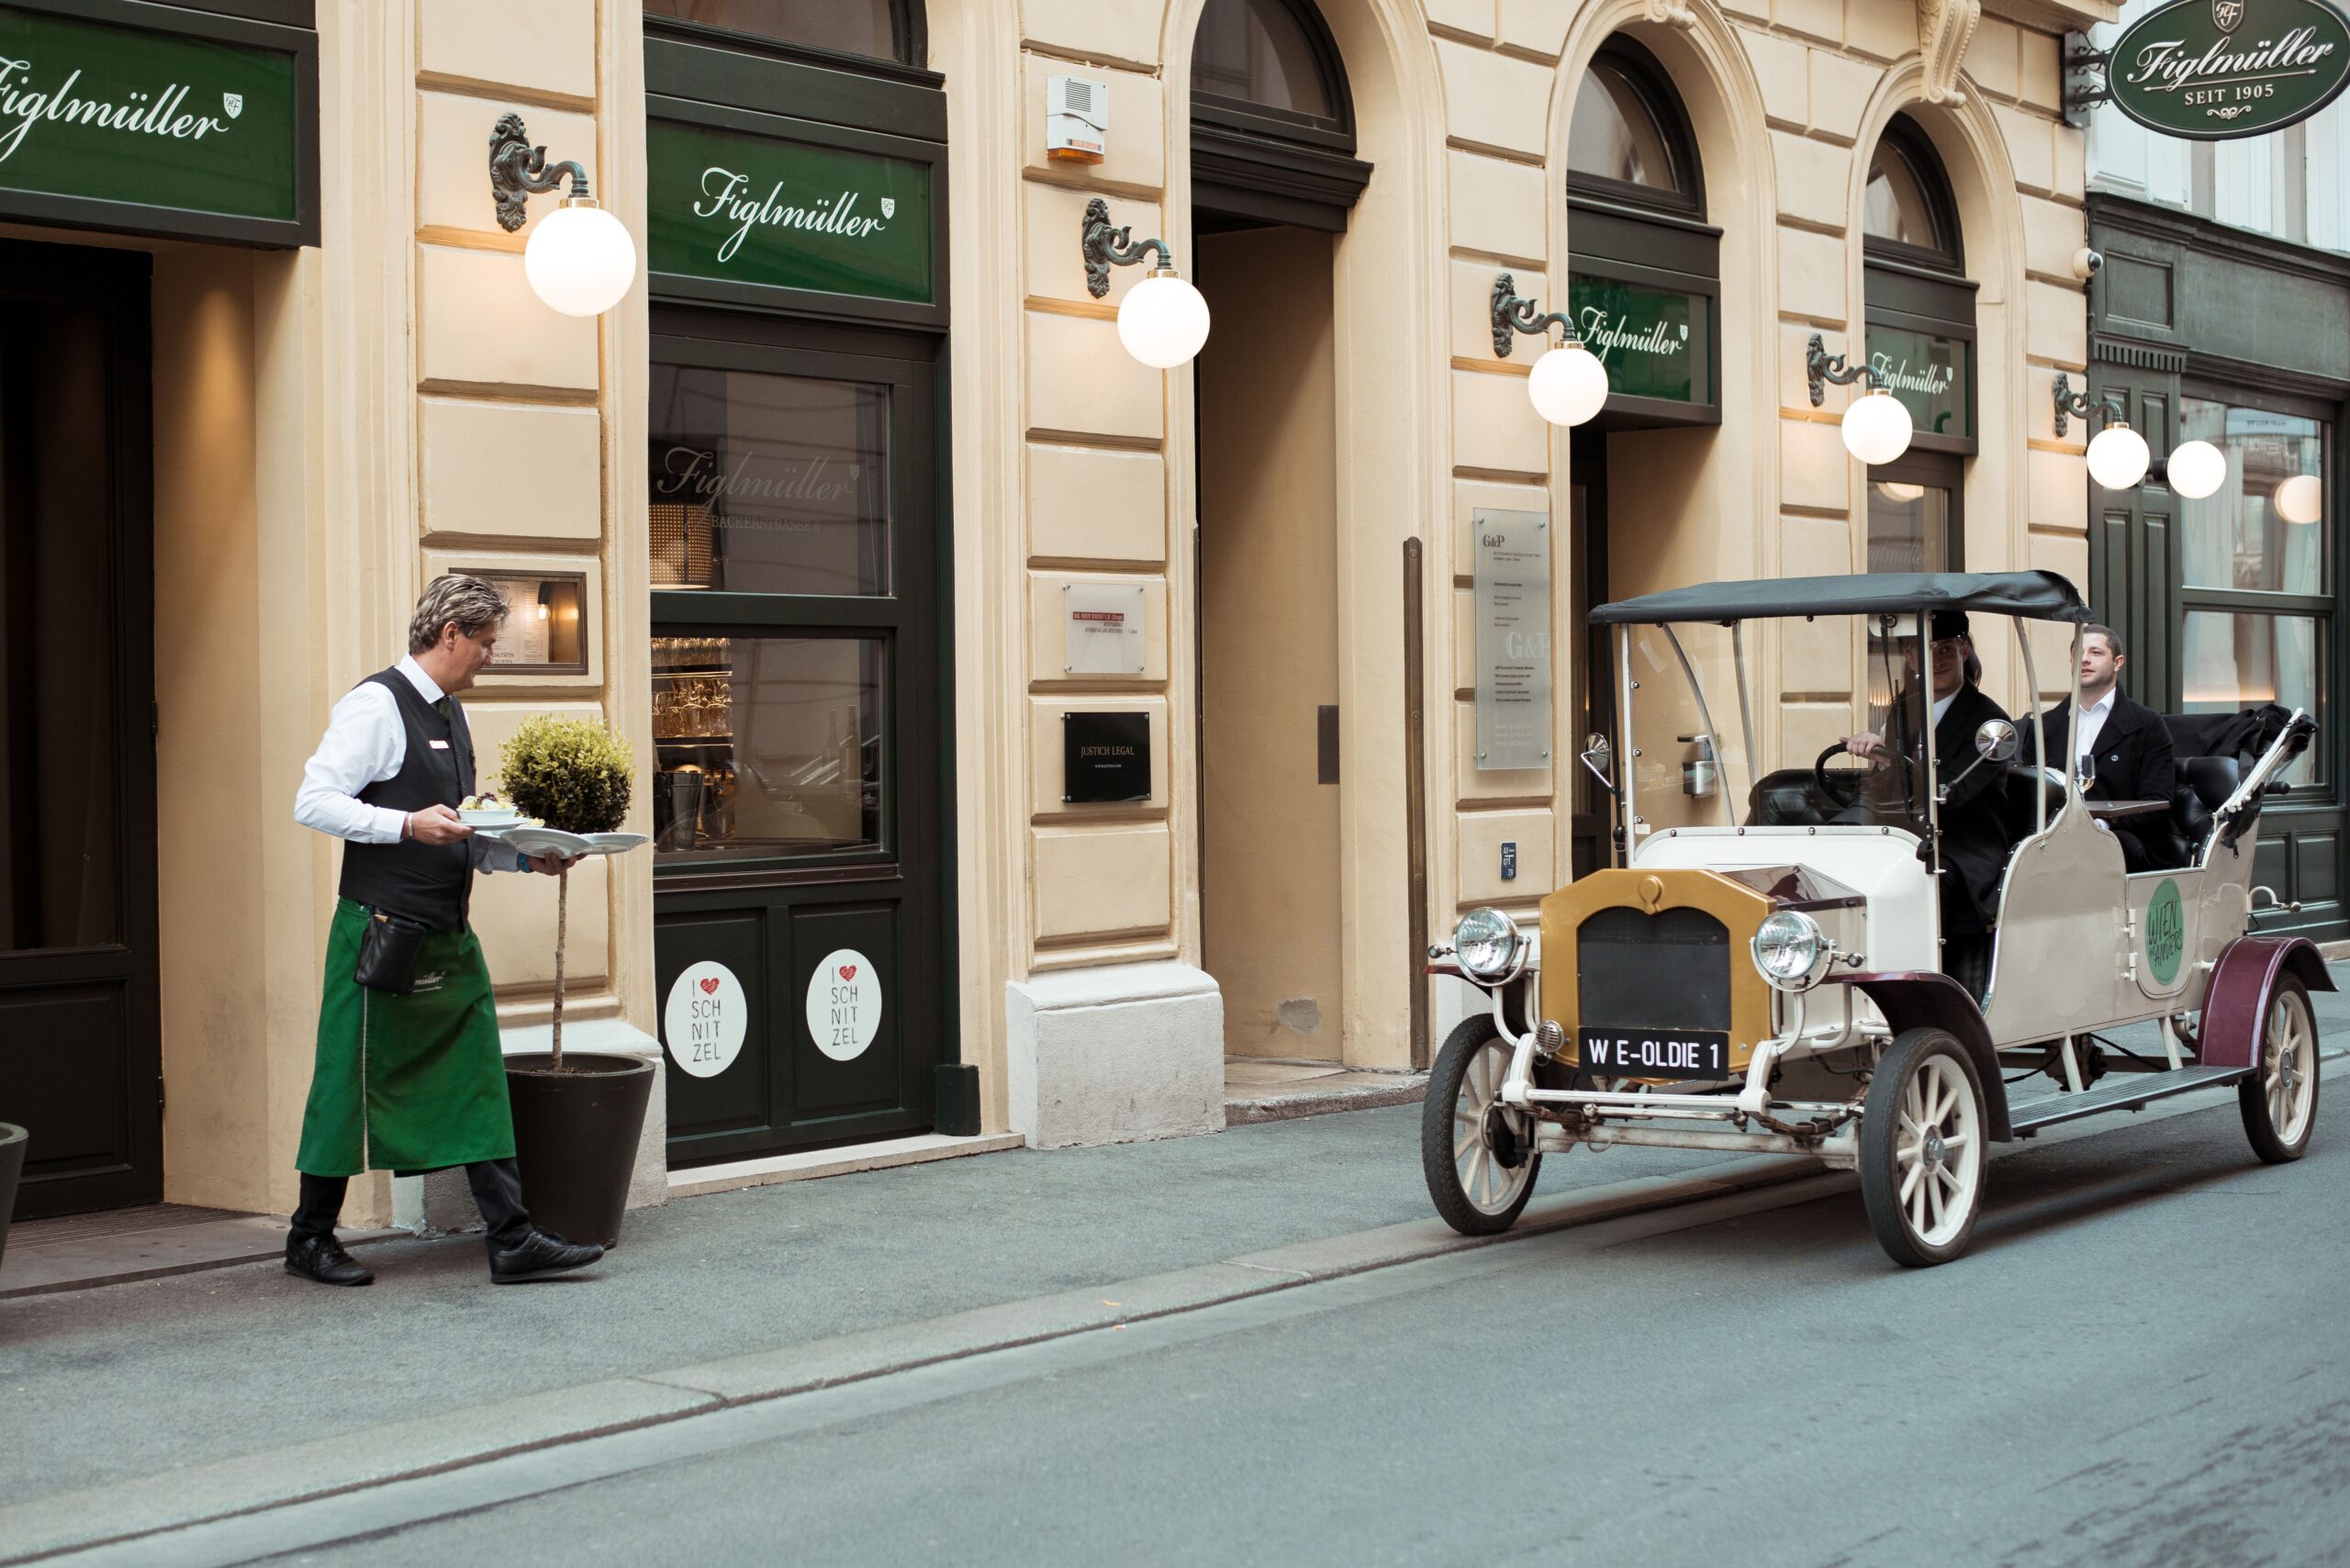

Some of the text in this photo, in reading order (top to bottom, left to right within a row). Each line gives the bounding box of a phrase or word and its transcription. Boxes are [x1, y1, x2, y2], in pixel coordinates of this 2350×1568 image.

[2126, 26, 2335, 92] Figlmüller
[2184, 84, 2275, 106] SEIT 1905
[693, 166, 886, 263] Figlmüller
[1576, 306, 1683, 364] Figlmüller
[1869, 351, 1949, 395] Figlmüller
[656, 446, 854, 532] Figlmüller
[1482, 534, 1505, 547] G&P
[1080, 745, 1136, 758] JUSTICH LEGAL
[2148, 899, 2179, 946] WIEN
[2154, 927, 2183, 967] ANDERS
[831, 966, 834, 983] I
[691, 979, 696, 997] I
[831, 985, 858, 1004] SCH
[691, 999, 722, 1019] SCH
[831, 1005, 858, 1025] NIT
[691, 1020, 722, 1040] NIT
[832, 1027, 859, 1047] ZEL
[692, 1042, 722, 1062] ZEL
[1588, 1038, 1718, 1070] W E-OLDIE 1
